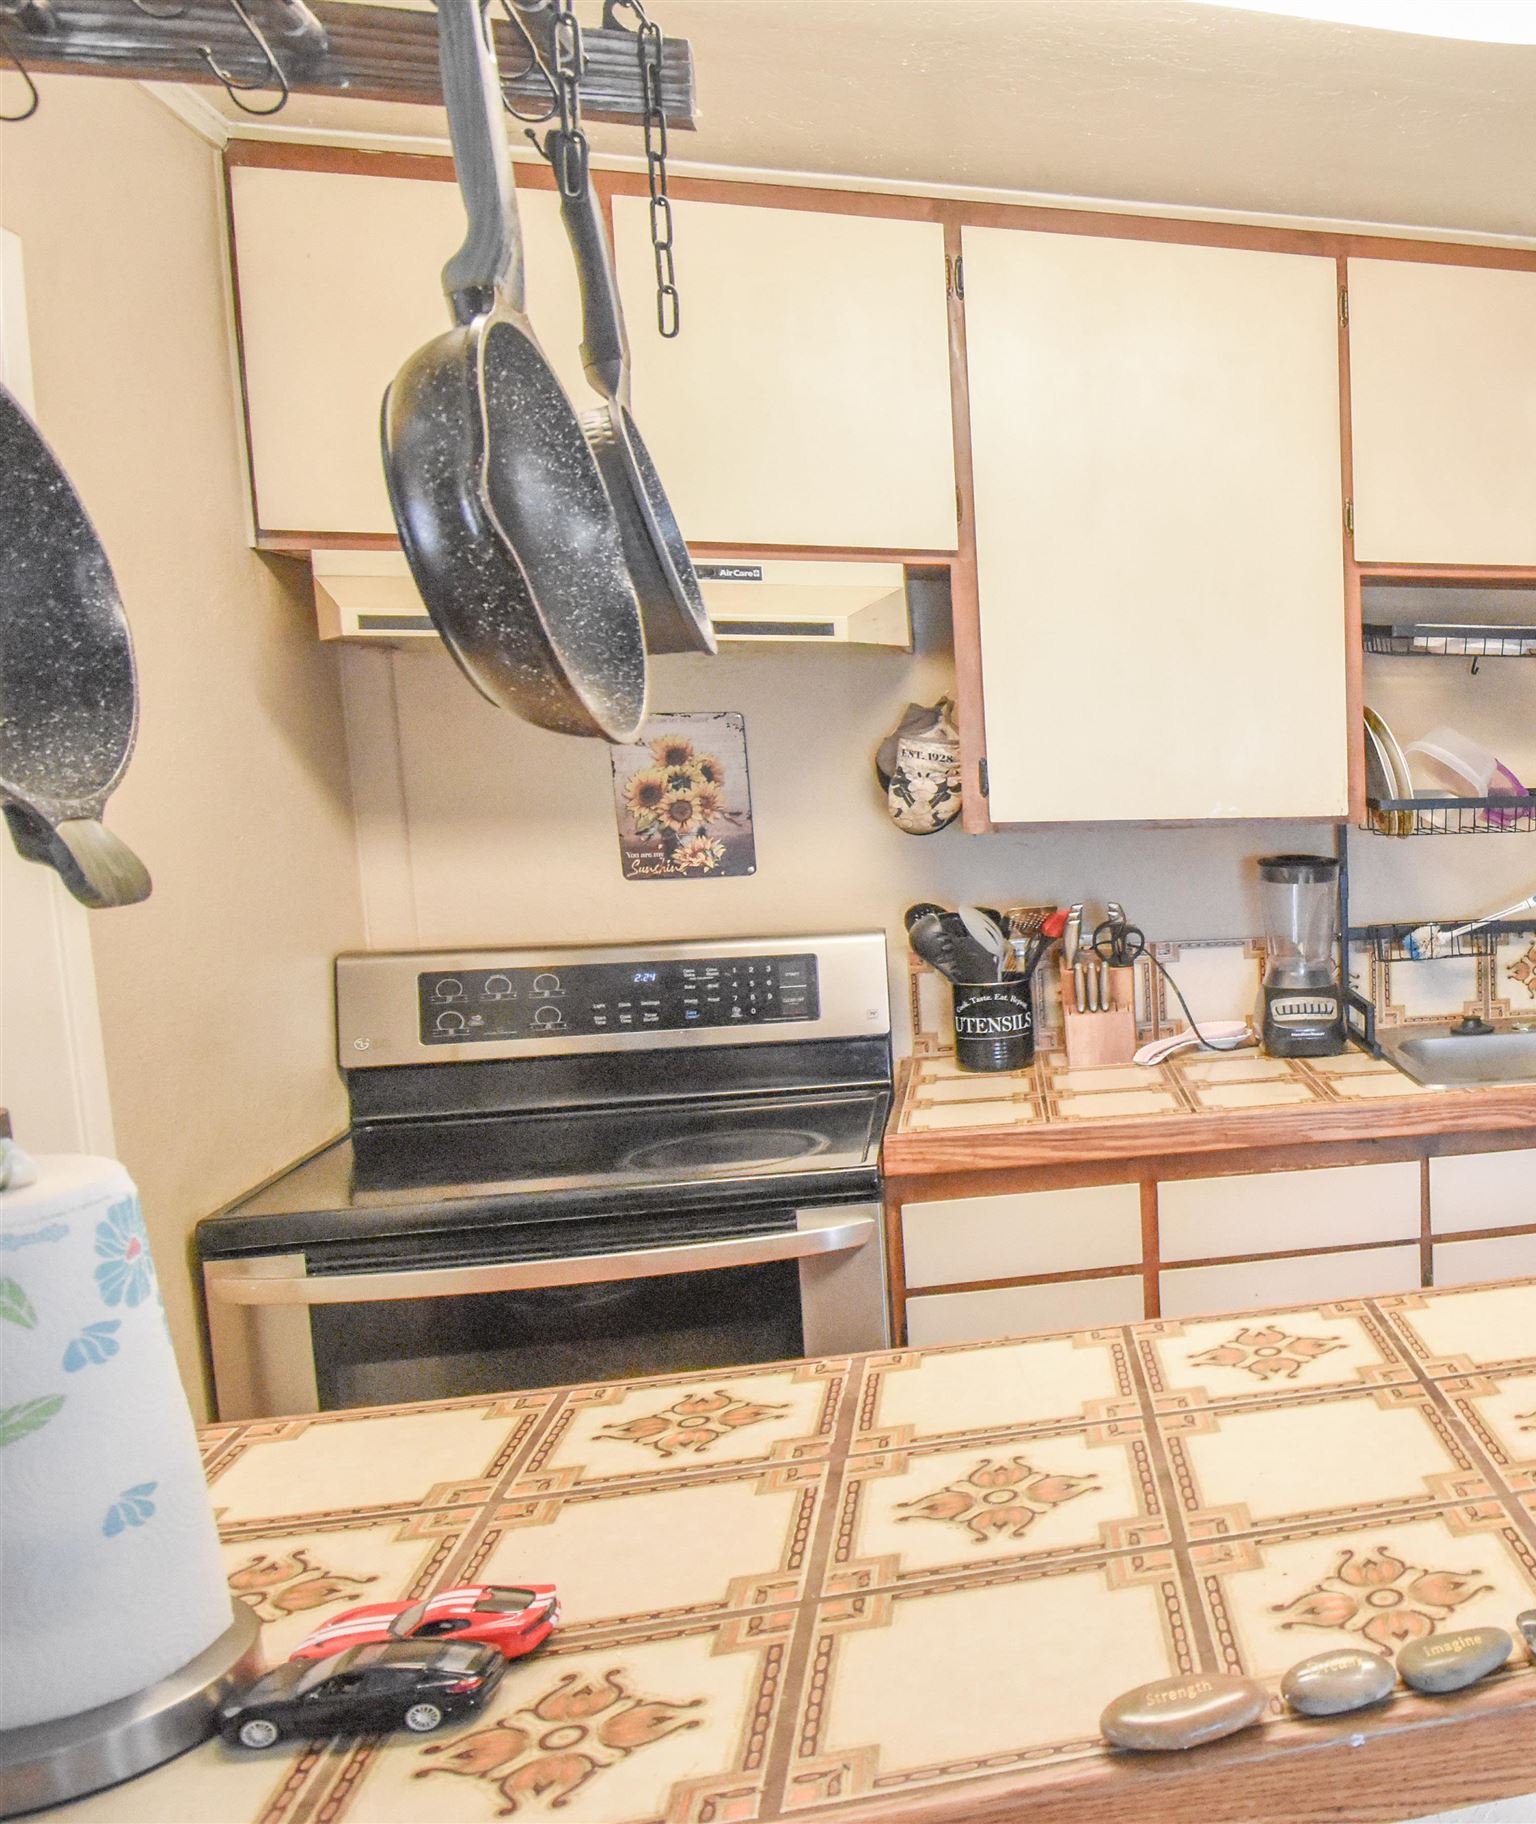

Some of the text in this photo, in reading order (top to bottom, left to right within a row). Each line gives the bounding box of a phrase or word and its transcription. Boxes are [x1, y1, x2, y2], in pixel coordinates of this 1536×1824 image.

[902, 748, 954, 763] EST. 1928
[625, 851, 640, 859] You
[653, 852, 665, 860] my
[765, 965, 772, 973] 3
[633, 972, 657, 983] 2:24
[969, 995, 993, 1004] Taste.
[994, 993, 1009, 1001] Eat.
[955, 1011, 1032, 1034] UTENSILS
[1146, 1680, 1213, 1706] Strength
